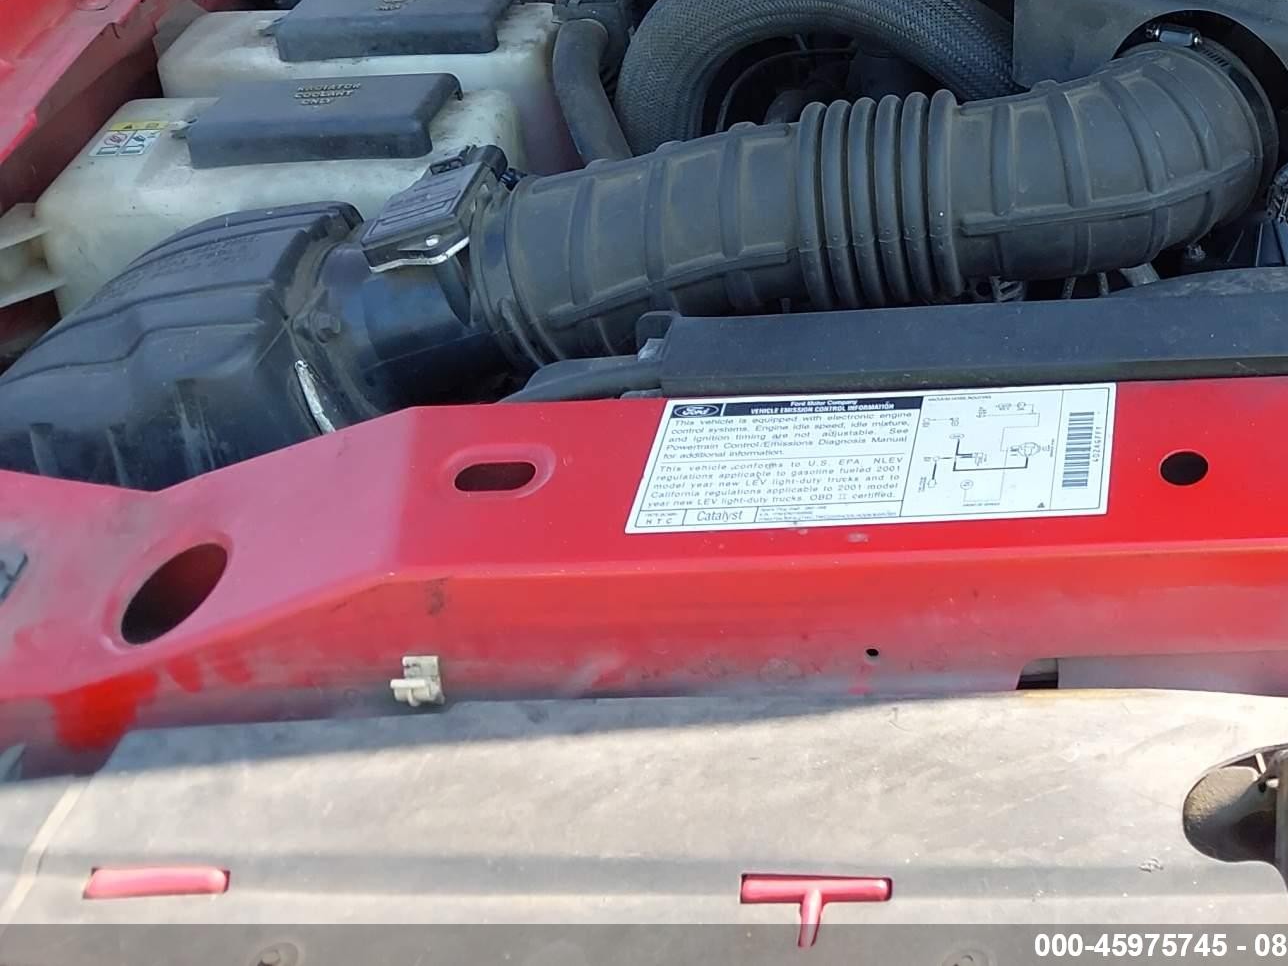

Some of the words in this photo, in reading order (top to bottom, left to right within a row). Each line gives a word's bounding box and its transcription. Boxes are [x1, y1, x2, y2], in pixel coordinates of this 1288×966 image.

[752, 416, 798, 425] equipped
[827, 413, 874, 421] electronic
[755, 424, 789, 432] Engine
[693, 434, 730, 443] ignition
[736, 433, 766, 442] timing
[666, 443, 719, 452] Powertrain
[818, 437, 866, 446] Diagnosis
[680, 450, 726, 458] additional
[733, 462, 783, 470] conforms
[656, 473, 713, 482] regulations
[718, 470, 772, 480] applicable
[791, 468, 835, 477] gasoline
[772, 476, 822, 485] light-duty
[704, 488, 761, 497] regulations
[766, 484, 818, 494] applicable
[867, 482, 899, 490] model
[648, 500, 669, 508] year
[721, 495, 768, 505] light-duty
[809, 493, 833, 501] OBD
[697, 510, 743, 522] Catalyst
